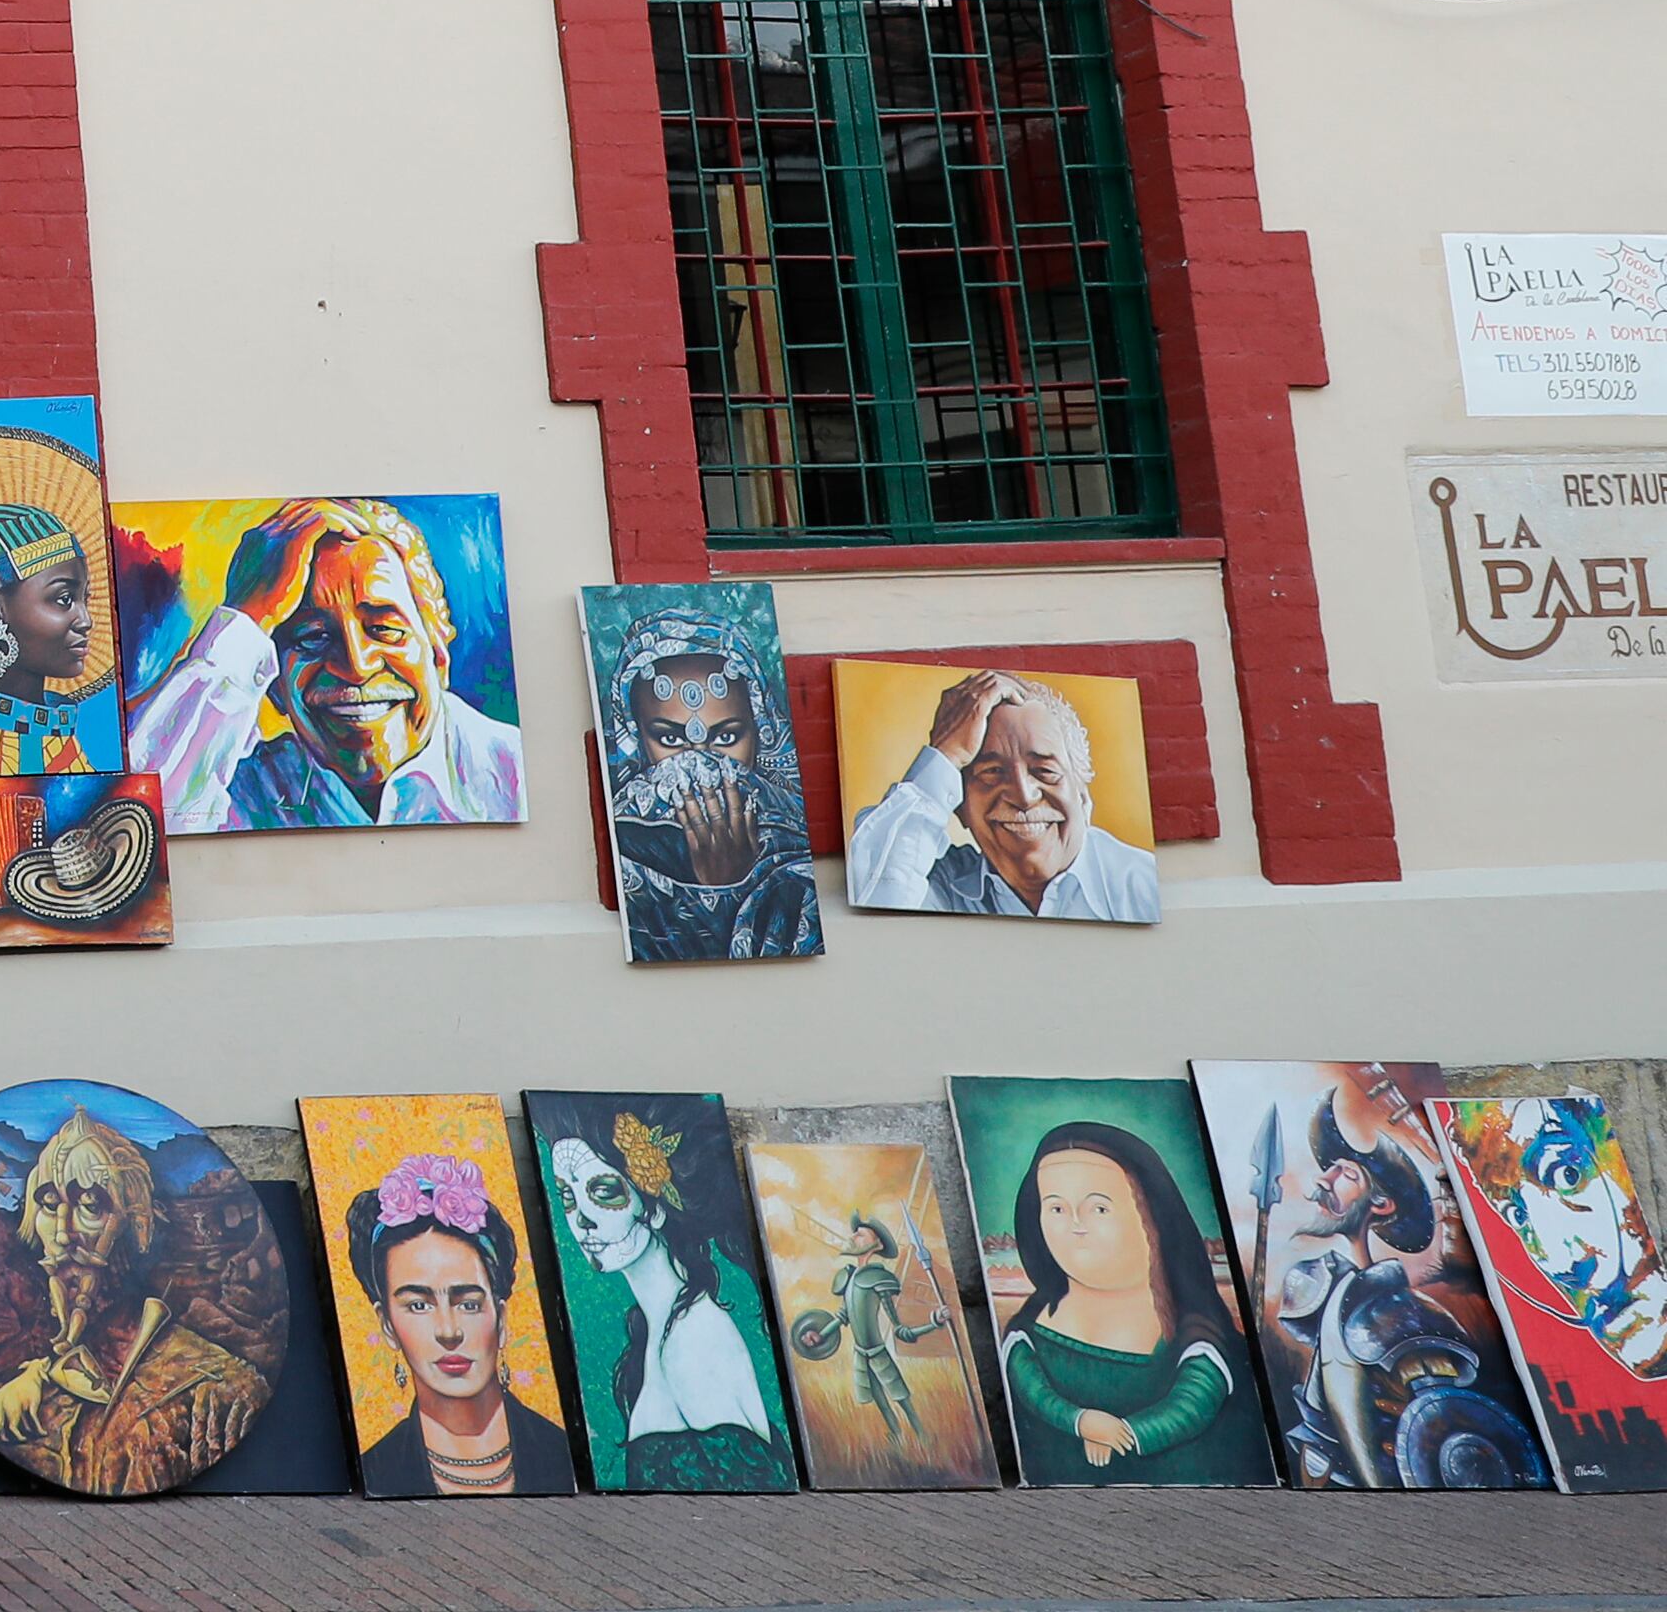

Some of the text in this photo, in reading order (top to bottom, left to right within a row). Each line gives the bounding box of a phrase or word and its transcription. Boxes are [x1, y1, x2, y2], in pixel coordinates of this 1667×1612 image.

[1482, 245, 1515, 266] LA
[1621, 249, 1658, 279] TODOS
[1487, 269, 1584, 293] PAELLA
[1626, 270, 1650, 289] LOS
[1471, 311, 1576, 341] ATENDEMOS
[1587, 327, 1597, 340] A
[1495, 354, 1541, 373] TELS
[1547, 378, 1637, 401] 6595028
[1474, 514, 1541, 549] LA
[1607, 625, 1644, 658] De
